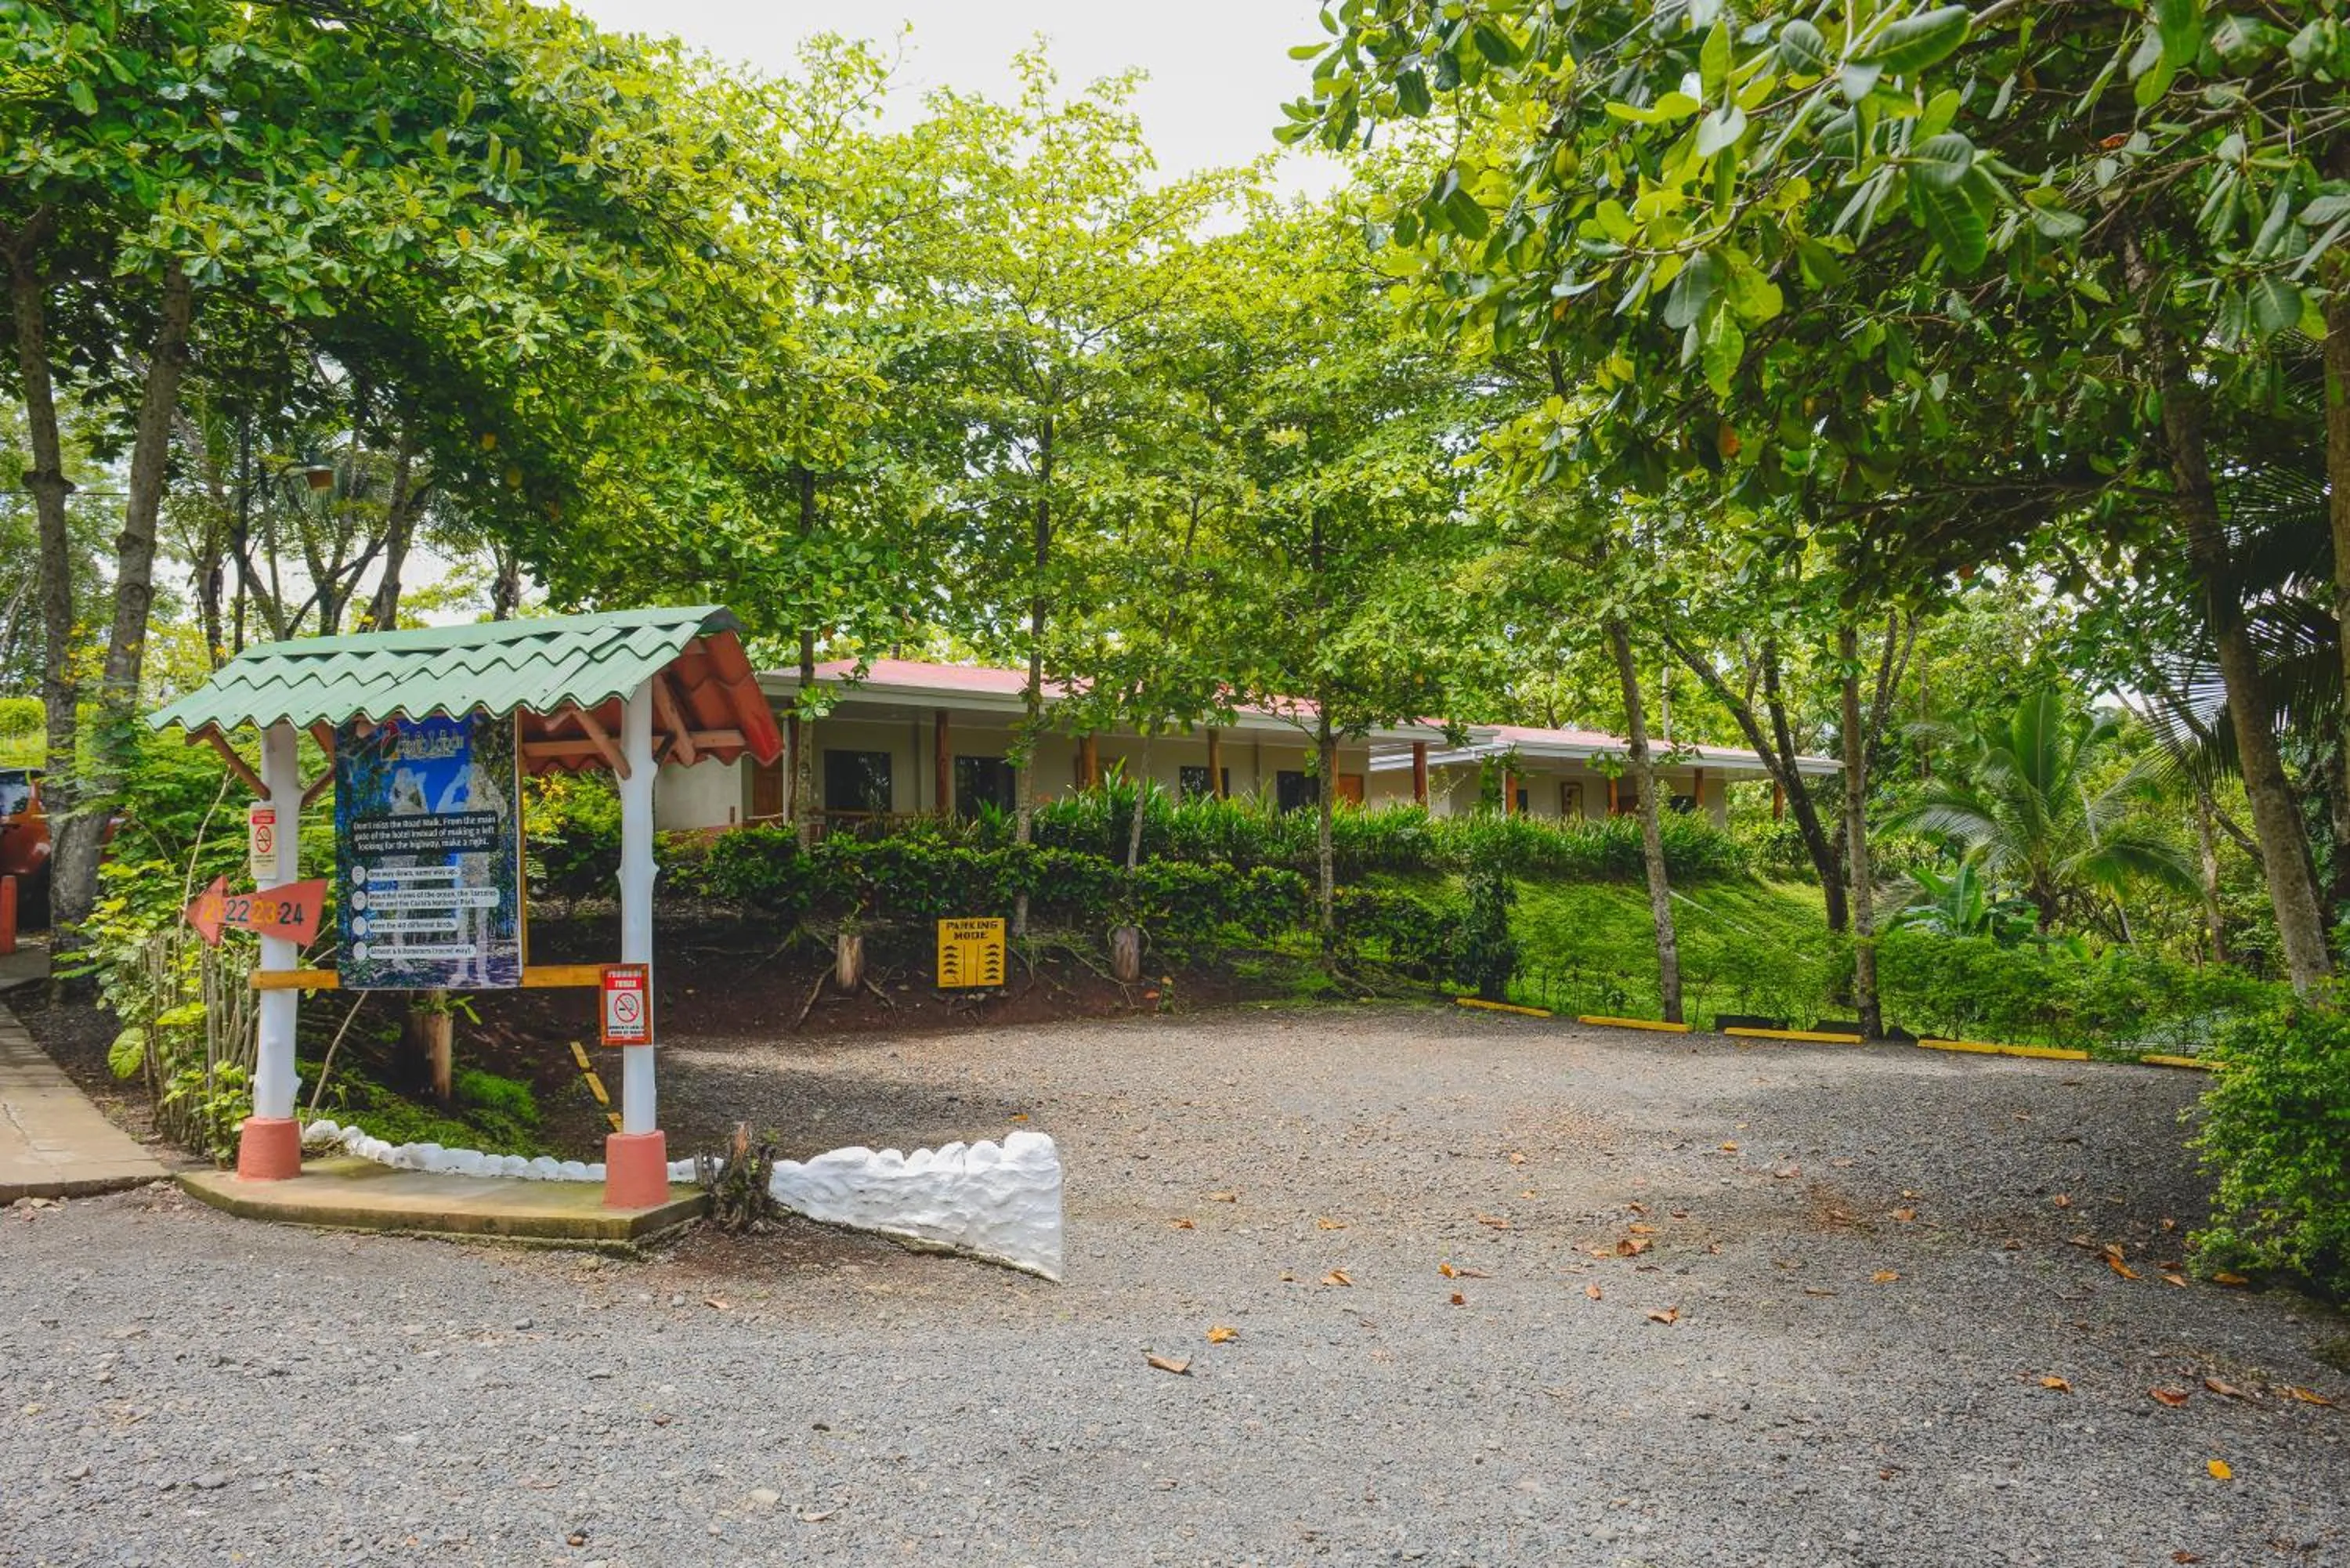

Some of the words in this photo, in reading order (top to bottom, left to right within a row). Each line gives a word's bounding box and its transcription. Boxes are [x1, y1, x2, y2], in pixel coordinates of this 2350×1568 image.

[443, 817, 462, 826] From
[478, 815, 495, 823] main
[354, 832, 370, 841] gate
[371, 831, 378, 840] of
[412, 829, 437, 837] instead
[448, 827, 475, 837] making
[482, 826, 494, 834] left
[359, 842, 385, 851] looking
[410, 839, 440, 849] highway,
[468, 838, 490, 847] right.
[226, 900, 251, 922] 22
[252, 900, 277, 922] 23
[279, 901, 304, 925] 24
[946, 921, 999, 930] PARKING
[953, 931, 988, 940] MODE
